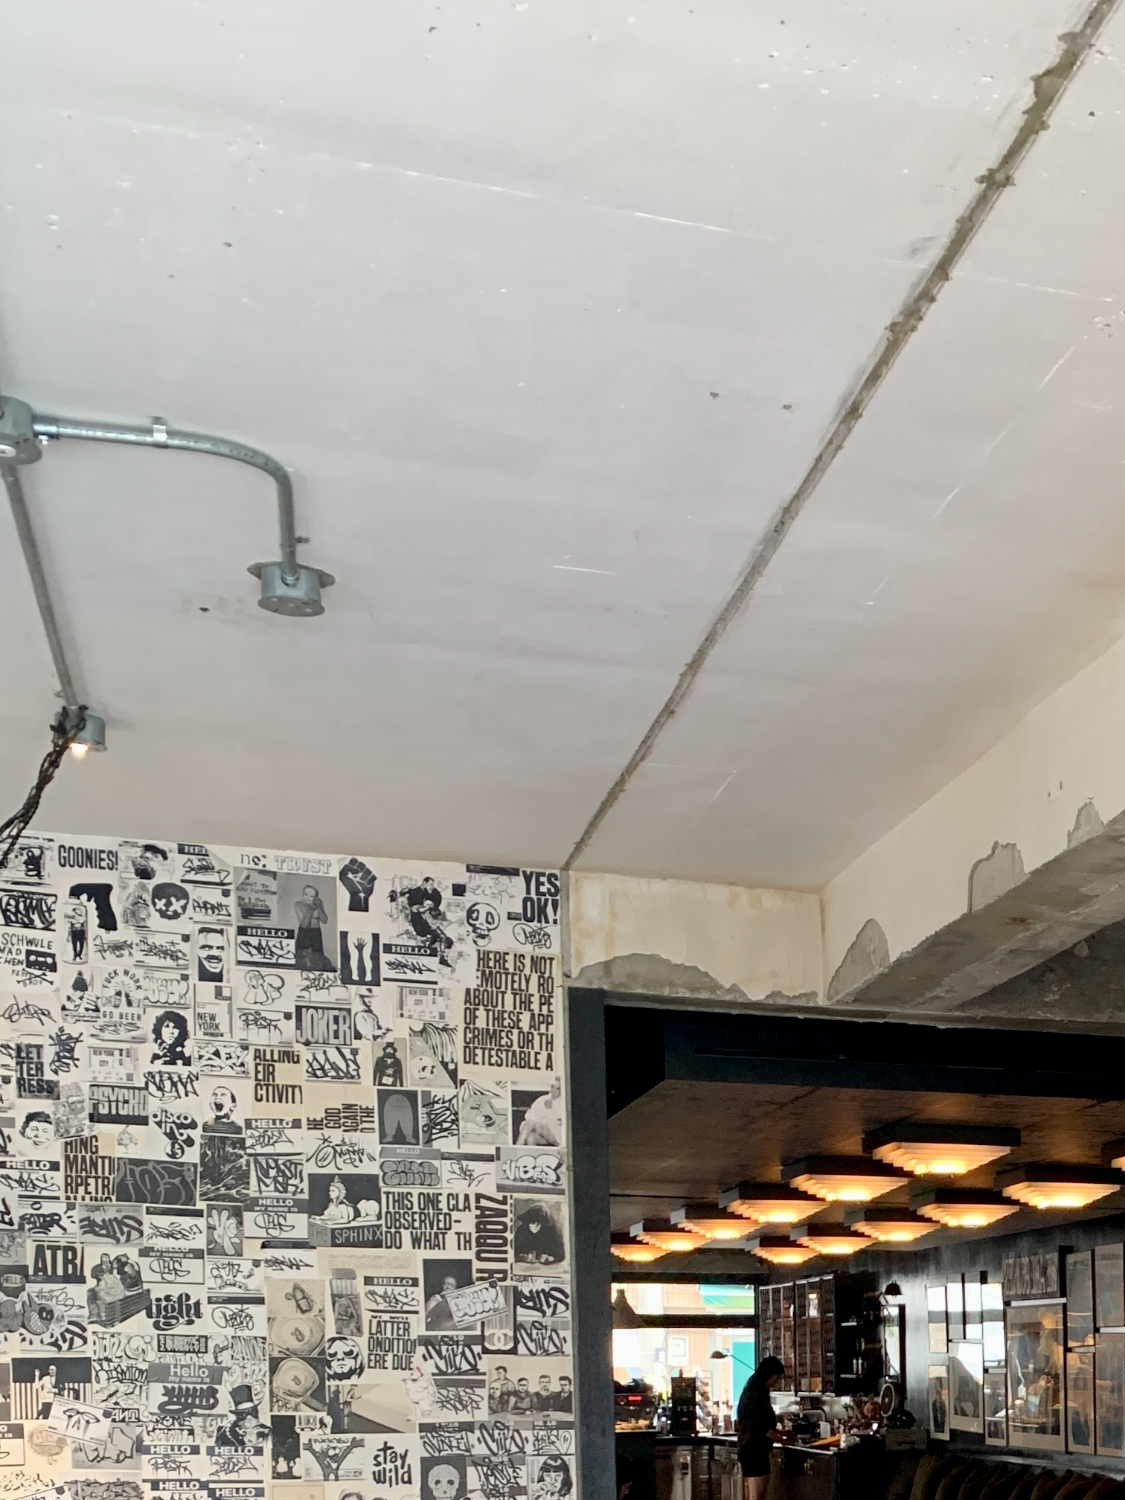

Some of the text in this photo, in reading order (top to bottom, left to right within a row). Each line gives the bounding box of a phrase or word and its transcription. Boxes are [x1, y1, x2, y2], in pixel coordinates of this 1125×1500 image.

[58, 844, 119, 871] GOONIES!
[521, 870, 559, 898] YES
[522, 896, 559, 925] OK!
[247, 927, 288, 937] HELLO
[391, 945, 431, 955] HELLO
[514, 953, 526, 973] IS
[530, 955, 555, 977] NOT
[102, 968, 143, 990] FUCK WORK
[476, 968, 532, 993] MOTELY
[464, 987, 507, 1009] ABOUT
[511, 992, 535, 1012] THE
[118, 1011, 142, 1021] BEER
[197, 1012, 217, 1022] NEW
[296, 1007, 351, 1045] JOKER
[464, 1007, 554, 1032] OF THESE APP
[197, 1022, 221, 1032] YORK
[463, 1026, 514, 1049] CRIMES
[517, 1031, 535, 1051] OR
[254, 1048, 300, 1064] ALLING
[463, 1046, 542, 1071] DETESTABLE
[254, 1062, 276, 1083] EIR
[89, 1085, 149, 1116] PSYCHO
[251, 1119, 293, 1128] HELLO
[325, 1107, 342, 1129] GOD
[6, 1161, 51, 1170] HELLO
[258, 1198, 294, 1206] HELLO
[383, 1191, 472, 1213] THIS ONE CLA
[334, 1226, 383, 1244] SPHINX
[384, 1230, 403, 1250] DO
[410, 1230, 448, 1250] WHAT
[33, 1244, 85, 1276] ATR
[373, 1277, 413, 1286] HELLO
[368, 1319, 411, 1338] LATTER
[170, 1364, 209, 1377] Hello
[367, 1353, 389, 1370] ERE
[392, 1353, 415, 1371] DUE
[150, 1445, 191, 1454] HELLO
[214, 1446, 255, 1455] HELLO
[373, 1441, 409, 1470] stay
[159, 1481, 200, 1490] HELLO
[372, 1464, 413, 1488] wild
[215, 1488, 256, 1497] HELLO
